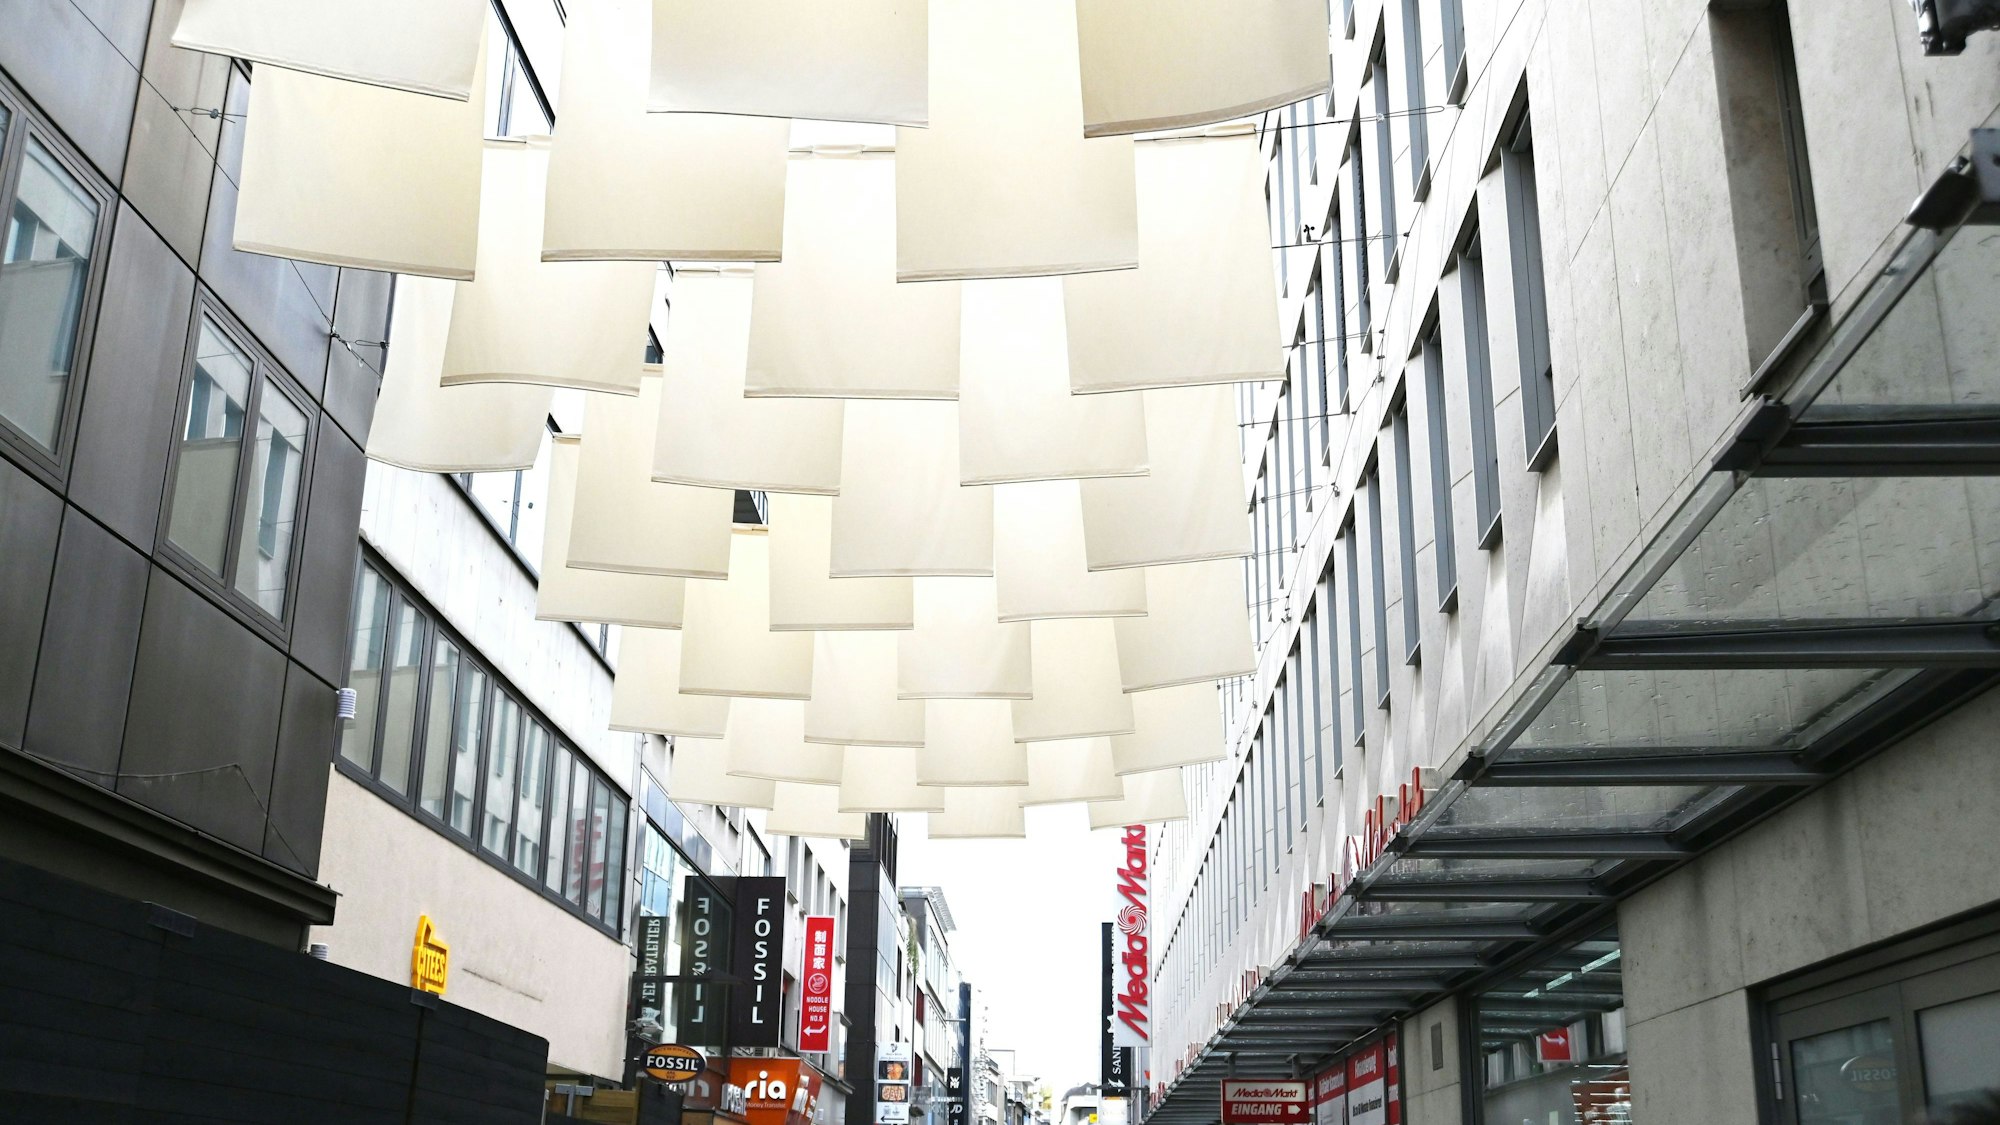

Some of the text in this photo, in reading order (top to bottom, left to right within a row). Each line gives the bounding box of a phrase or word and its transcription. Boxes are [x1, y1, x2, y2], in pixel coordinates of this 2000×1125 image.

[416, 946, 446, 985] CITEES
[750, 897, 771, 1025] FOSSIL
[1117, 931, 1149, 1041] Media
[806, 996, 829, 1004] NOODLE
[808, 1005, 827, 1013] HOUSE
[646, 1055, 698, 1071] FOSSIL
[744, 1070, 787, 1100] ria
[1232, 1087, 1298, 1098] Media Markt
[949, 1104, 963, 1114] JD
[1231, 1103, 1282, 1116] EINGANG
